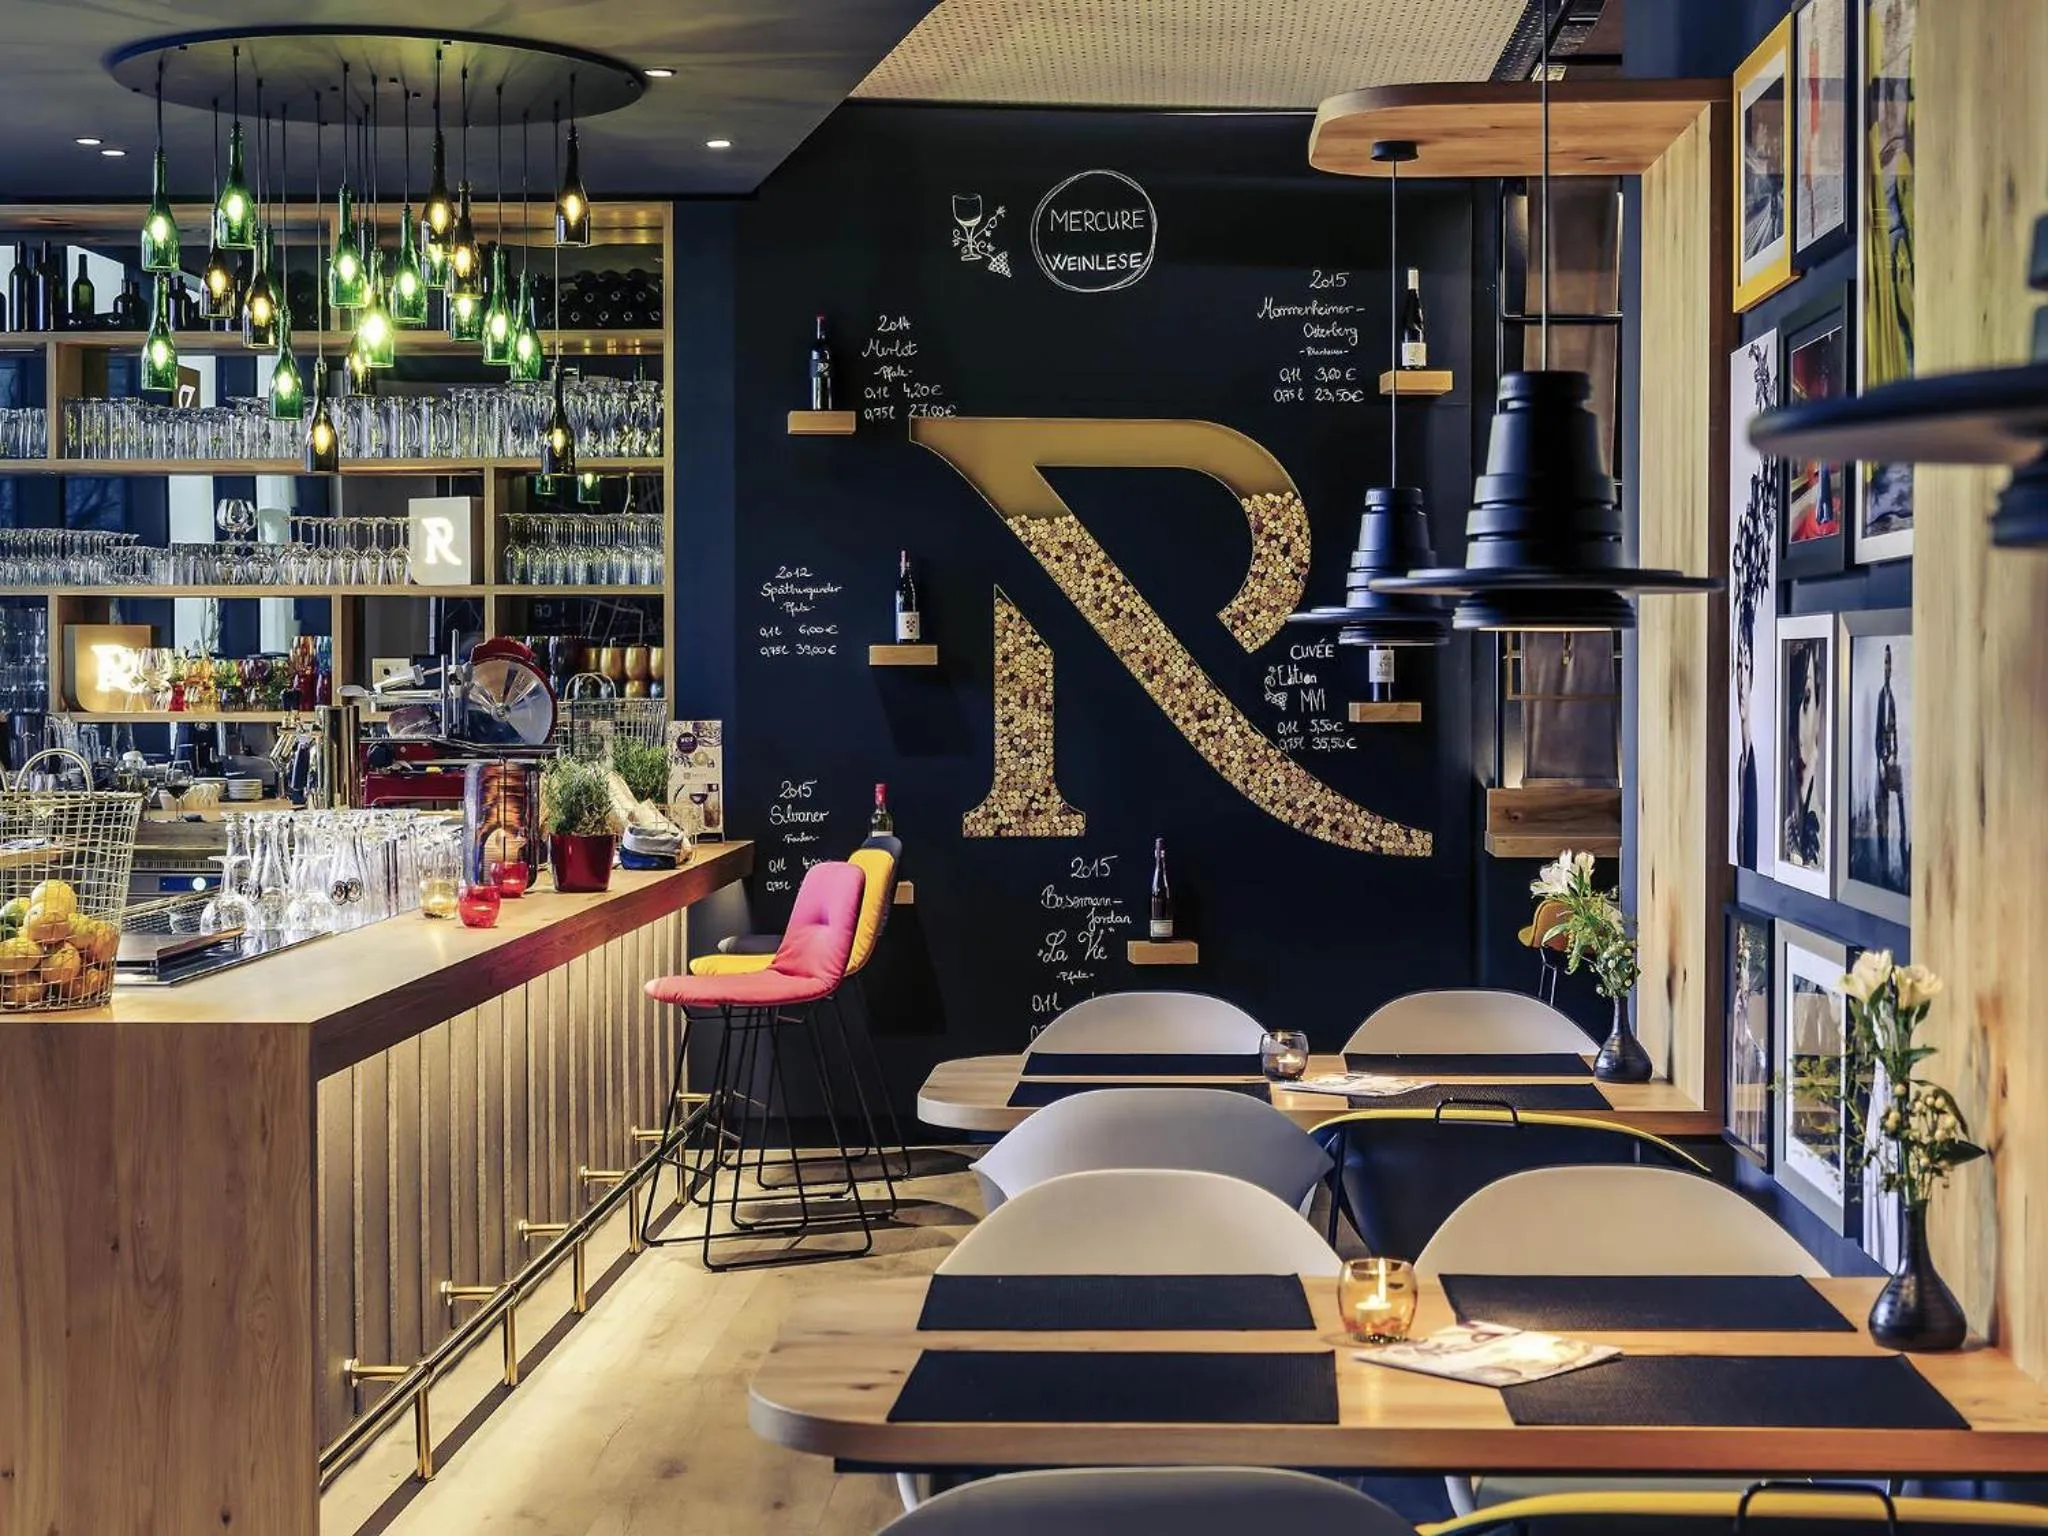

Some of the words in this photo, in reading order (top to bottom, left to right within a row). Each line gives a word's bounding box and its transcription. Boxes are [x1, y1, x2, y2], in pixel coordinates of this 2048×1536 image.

[1050, 210, 1146, 232] MERCURE
[1046, 253, 1143, 271] WEINLESE
[1309, 269, 1350, 288] 2015
[877, 314, 912, 333] 2014
[1303, 321, 1358, 346] Osterberg
[861, 338, 919, 357] Merlot
[421, 516, 462, 566] R
[775, 565, 814, 579] 2012
[909, 418, 1433, 858] R
[1290, 637, 1335, 660] CUVÉE
[1277, 663, 1318, 686] Edition
[779, 780, 818, 799] 2015
[1071, 855, 1119, 879] 2015
[1086, 907, 1133, 932] Jordan
